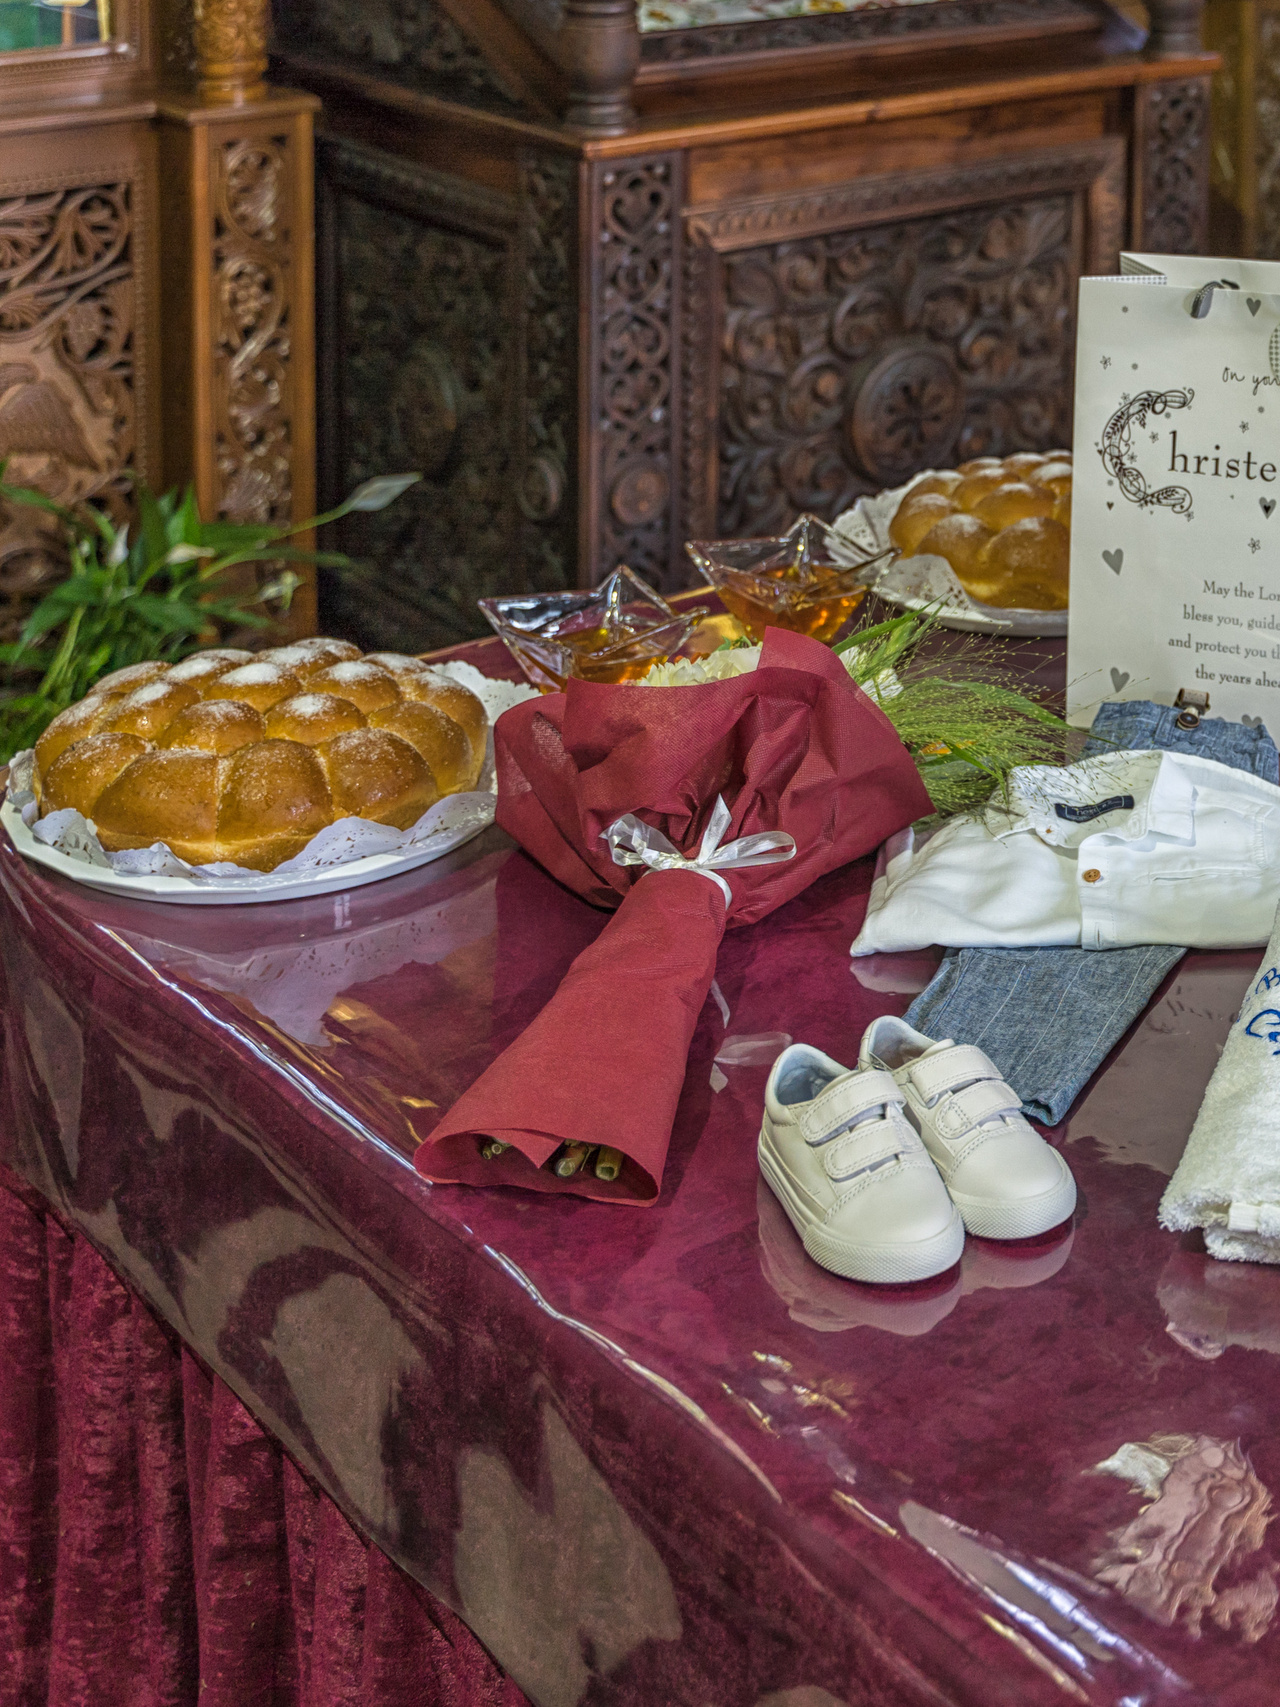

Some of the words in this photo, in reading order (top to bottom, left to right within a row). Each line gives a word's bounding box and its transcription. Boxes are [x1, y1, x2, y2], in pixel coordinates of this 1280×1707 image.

[1222, 366, 1245, 383] On
[1202, 580, 1231, 598] May
[1234, 582, 1254, 599] the
[1182, 604, 1214, 623] bless
[1217, 615, 1243, 628] you,
[1168, 633, 1192, 649] and
[1195, 640, 1241, 655] protect
[1244, 648, 1268, 659] you
[1195, 663, 1216, 681] the
[1218, 671, 1252, 685] years
